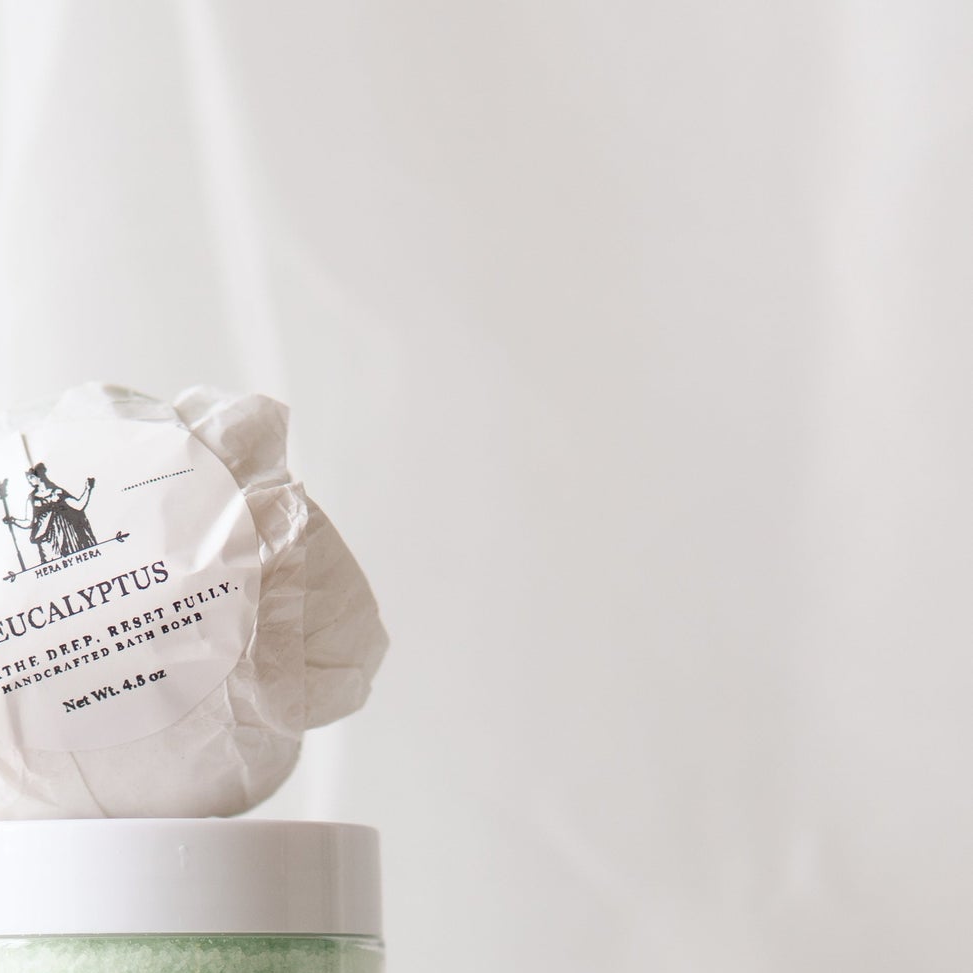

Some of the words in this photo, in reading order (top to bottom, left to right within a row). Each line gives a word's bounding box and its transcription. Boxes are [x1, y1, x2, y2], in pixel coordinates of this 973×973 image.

[35, 564, 61, 579] HERA
[62, 558, 73, 568] BY
[75, 549, 101, 563] HERA
[46, 635, 100, 660] DEEP.
[107, 608, 164, 637] RESET
[172, 582, 238, 612] FULLY.
[2, 648, 109, 694] HANDCRAFTED
[115, 630, 155, 651] BATH
[161, 612, 202, 634] BOMB
[62, 696, 91, 712] Net
[91, 686, 124, 701] Wt.
[123, 674, 145, 690] 4.5
[149, 670, 166, 682] oz
